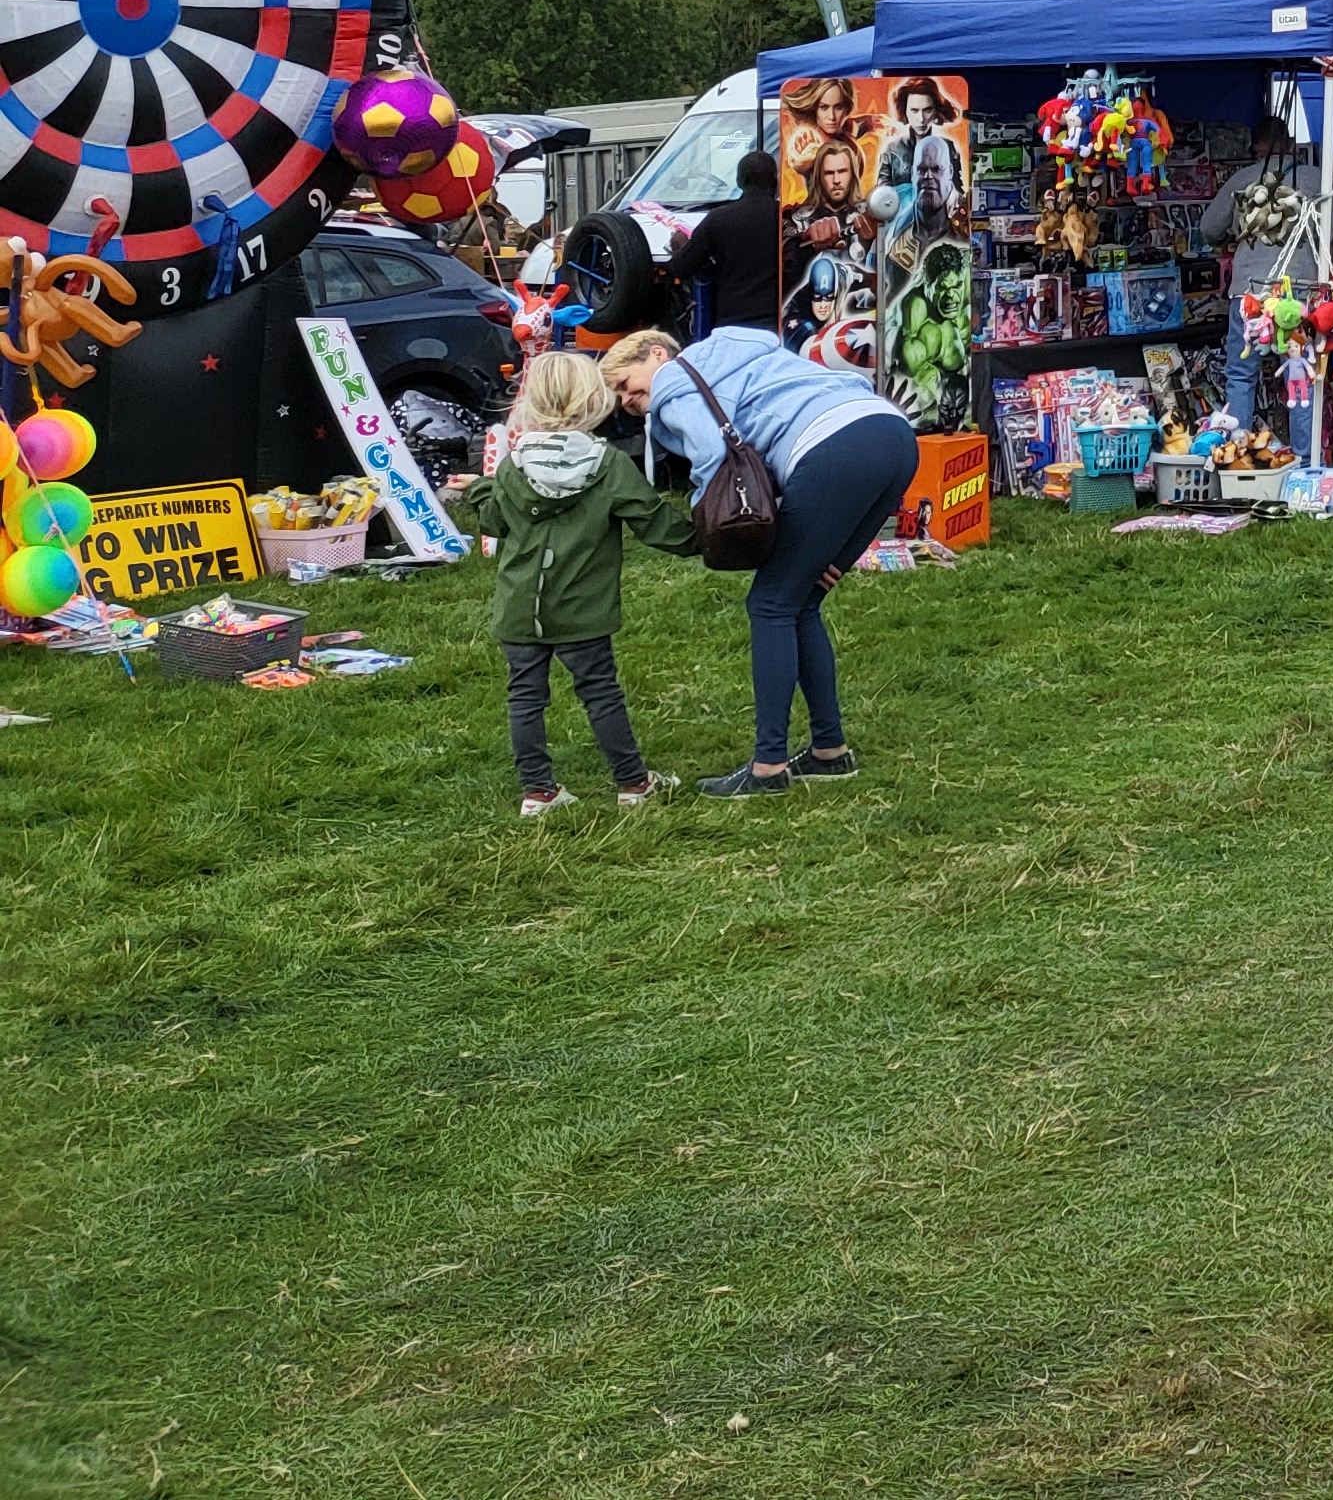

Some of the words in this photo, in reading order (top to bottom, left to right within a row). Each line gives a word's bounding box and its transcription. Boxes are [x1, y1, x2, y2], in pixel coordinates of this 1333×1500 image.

[375, 33, 403, 68] 10
[308, 188, 333, 222] 2
[236, 233, 268, 284] 17
[160, 267, 182, 306] 3
[307, 325, 369, 405] FUN
[356, 414, 380, 436] &
[942, 443, 985, 483] PRIZE
[161, 498, 232, 517] NUMBERS
[365, 442, 467, 558] GAMES
[941, 471, 987, 513] EVERY
[944, 501, 983, 541] TIME
[79, 531, 122, 564] TO
[133, 520, 203, 556] WIN
[127, 546, 245, 595] PRIZE
